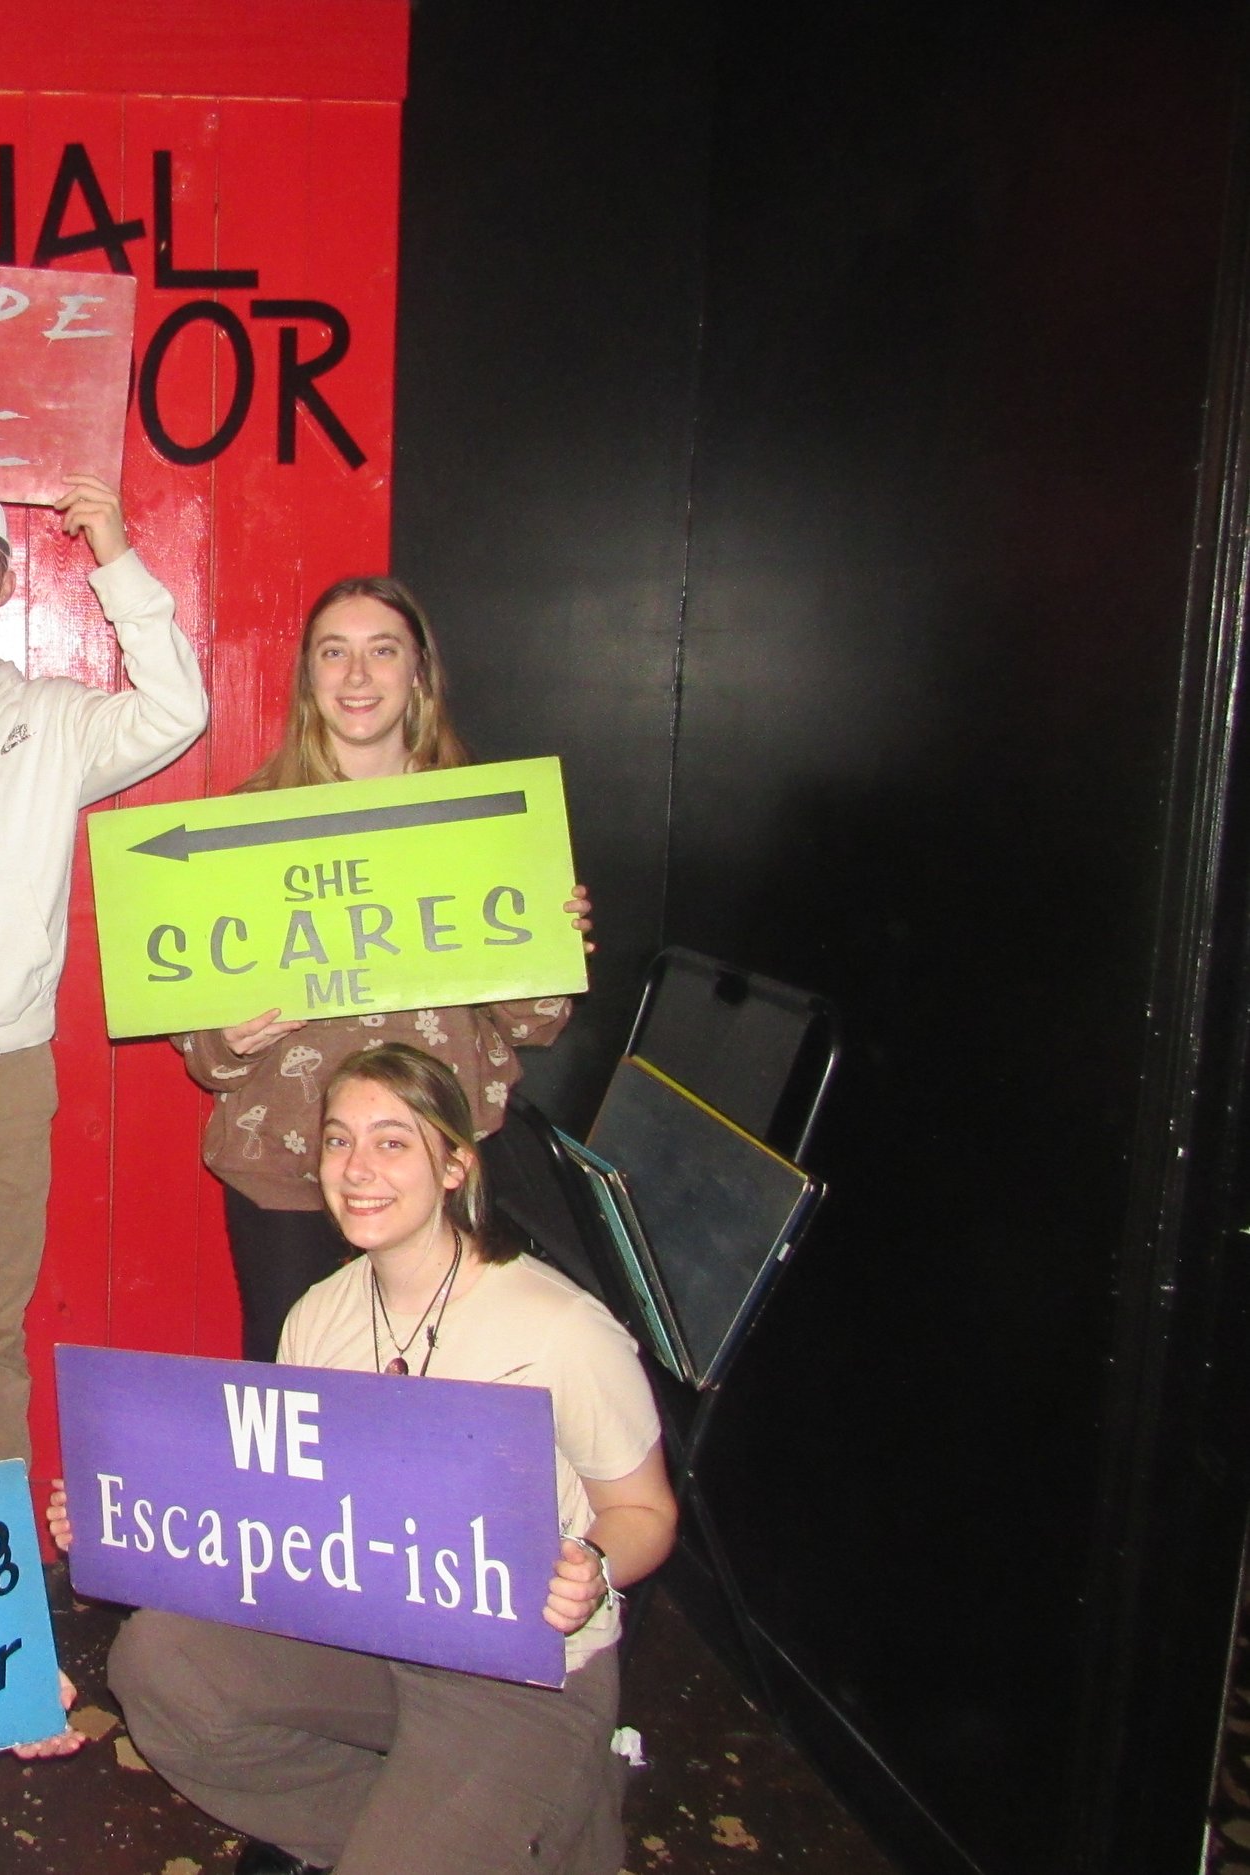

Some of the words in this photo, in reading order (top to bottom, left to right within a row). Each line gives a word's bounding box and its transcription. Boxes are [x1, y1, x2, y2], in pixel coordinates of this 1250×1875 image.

[128, 299, 368, 470] OR
[284, 859, 374, 902] SHE
[146, 886, 533, 982] SCARES
[305, 968, 375, 1009] ME
[223, 1383, 323, 1480] WE
[97, 1473, 518, 1621] Escaped-ish
